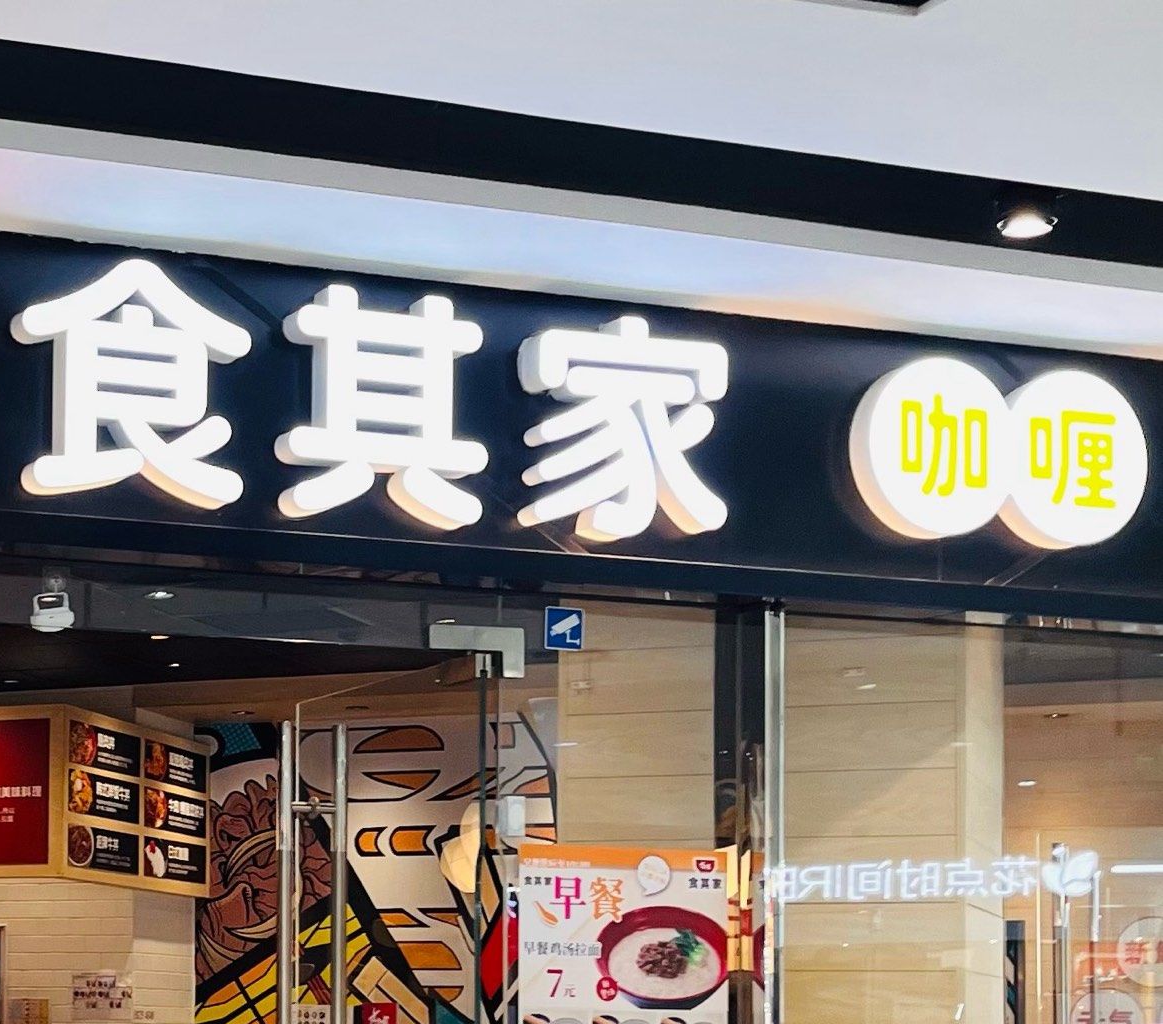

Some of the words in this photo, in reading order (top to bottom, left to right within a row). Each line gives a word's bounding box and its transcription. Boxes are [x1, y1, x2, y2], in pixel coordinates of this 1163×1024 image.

[14, 258, 729, 541] 食其家
[901, 393, 1117, 509] 咖喱
[549, 875, 625, 922] 早餐
